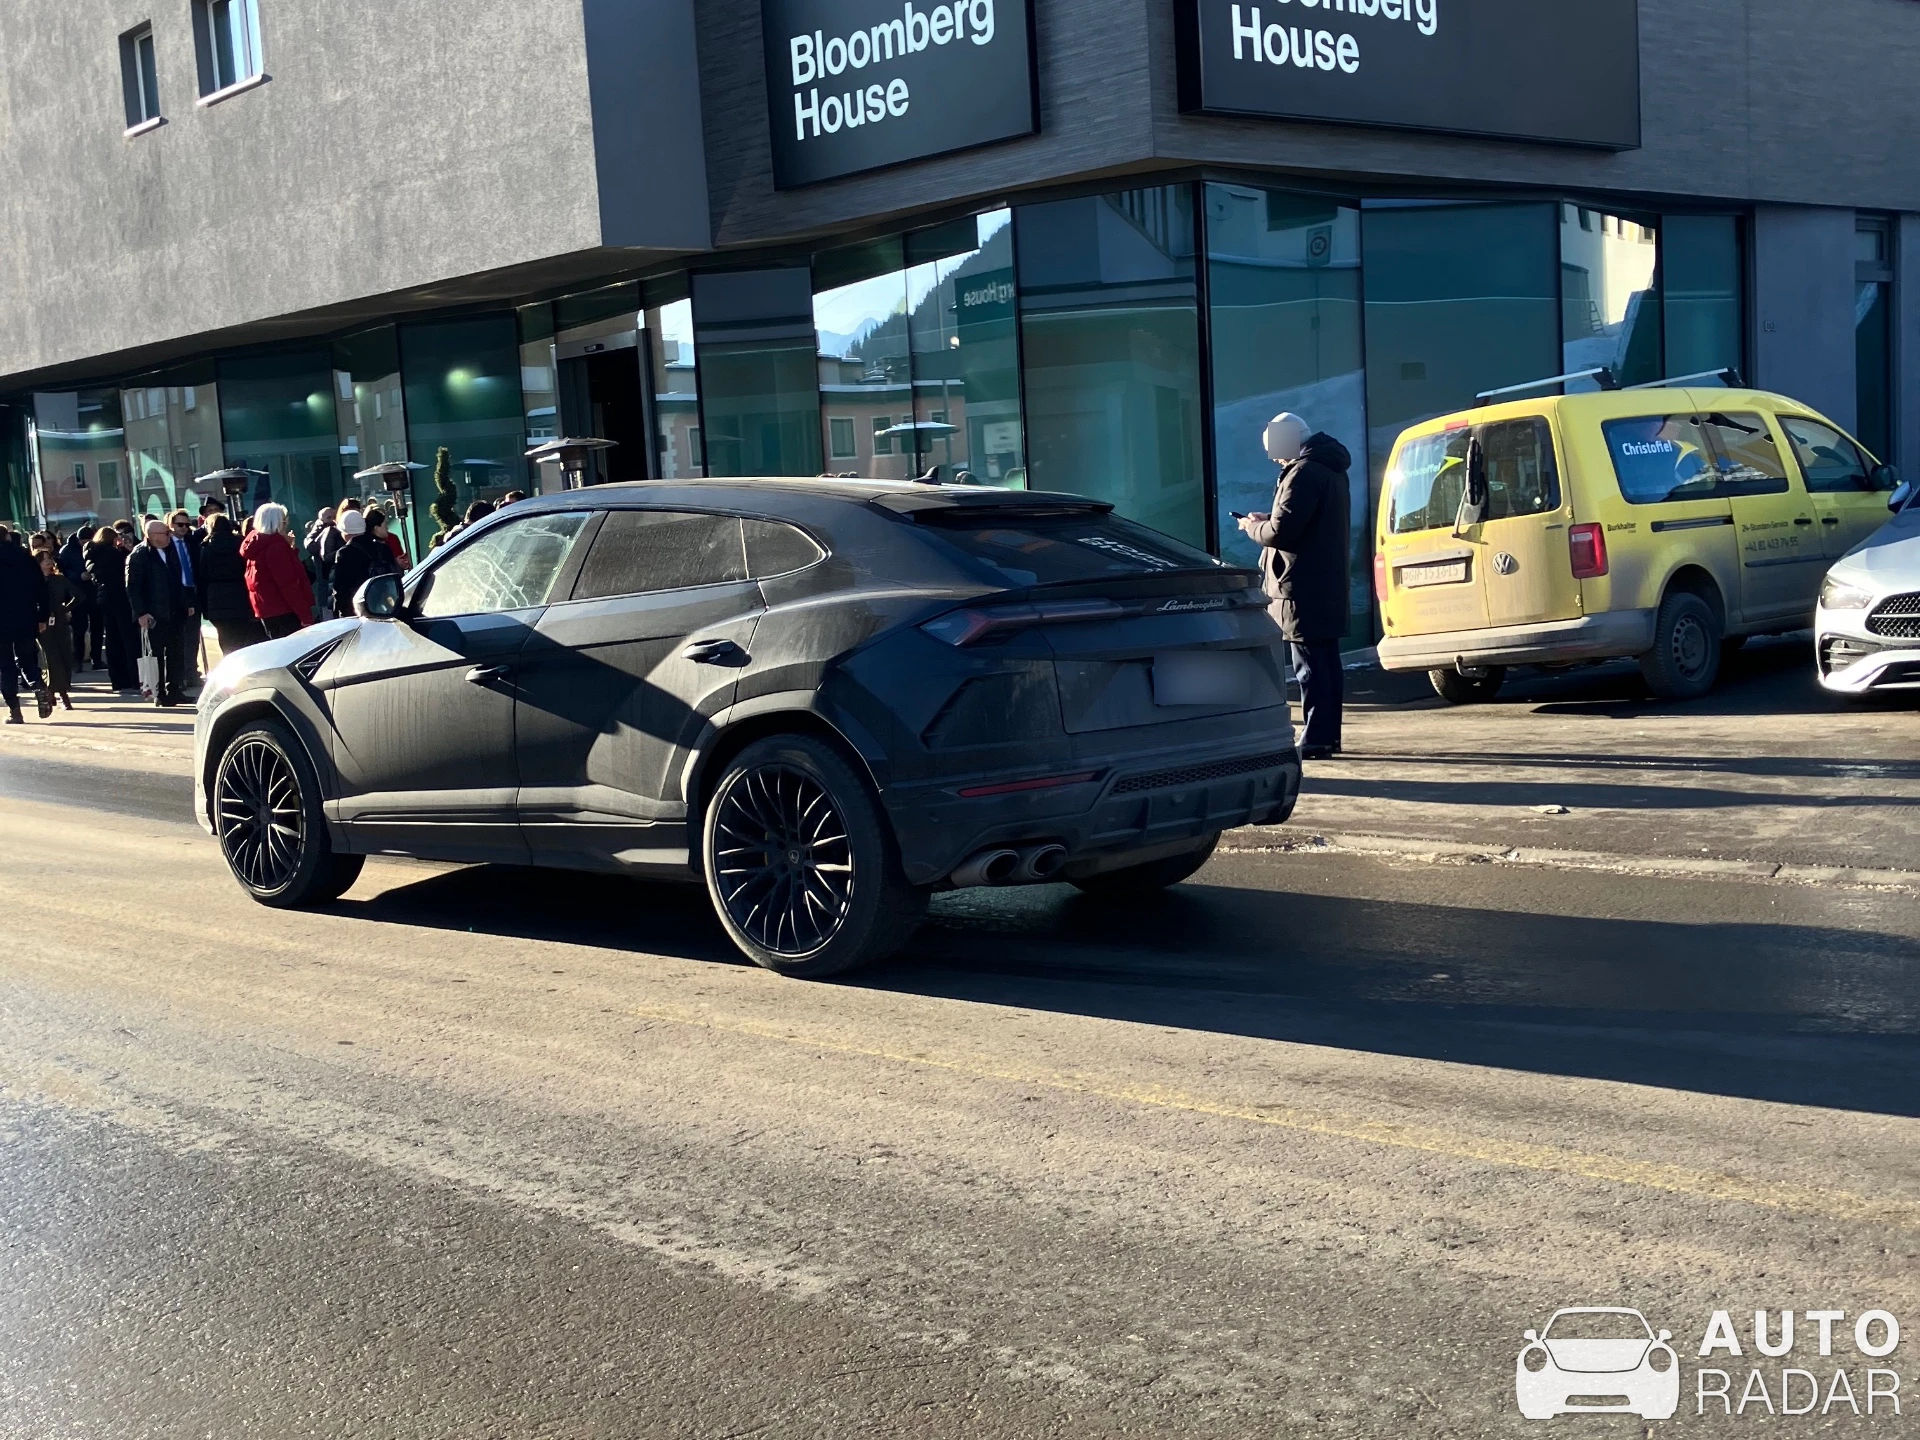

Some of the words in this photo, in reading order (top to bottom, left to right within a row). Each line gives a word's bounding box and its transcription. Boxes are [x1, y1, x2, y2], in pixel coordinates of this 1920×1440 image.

[790, 0, 995, 86] Bloomberg
[1231, 4, 1360, 74] House
[794, 78, 909, 140] House
[1621, 439, 1673, 456] Christoffel
[1155, 598, 1225, 612] Lamborghini
